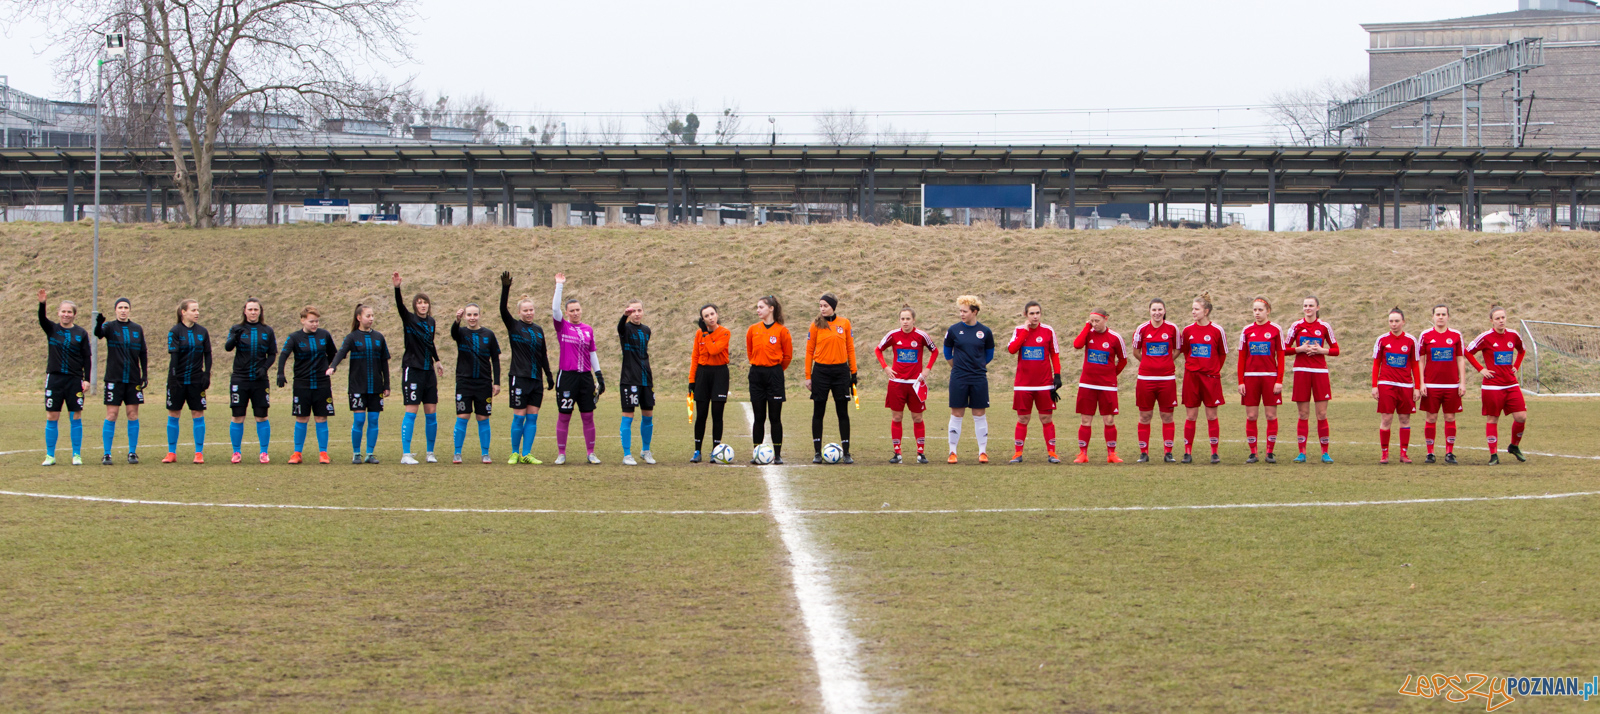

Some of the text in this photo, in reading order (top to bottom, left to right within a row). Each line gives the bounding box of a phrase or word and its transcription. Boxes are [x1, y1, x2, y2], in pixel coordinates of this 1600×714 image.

[107, 392, 114, 402] 3
[410, 391, 417, 401] 6
[515, 396, 521, 406] 5
[629, 394, 639, 405] 16
[352, 398, 364, 408] 24
[561, 398, 574, 409] 22
